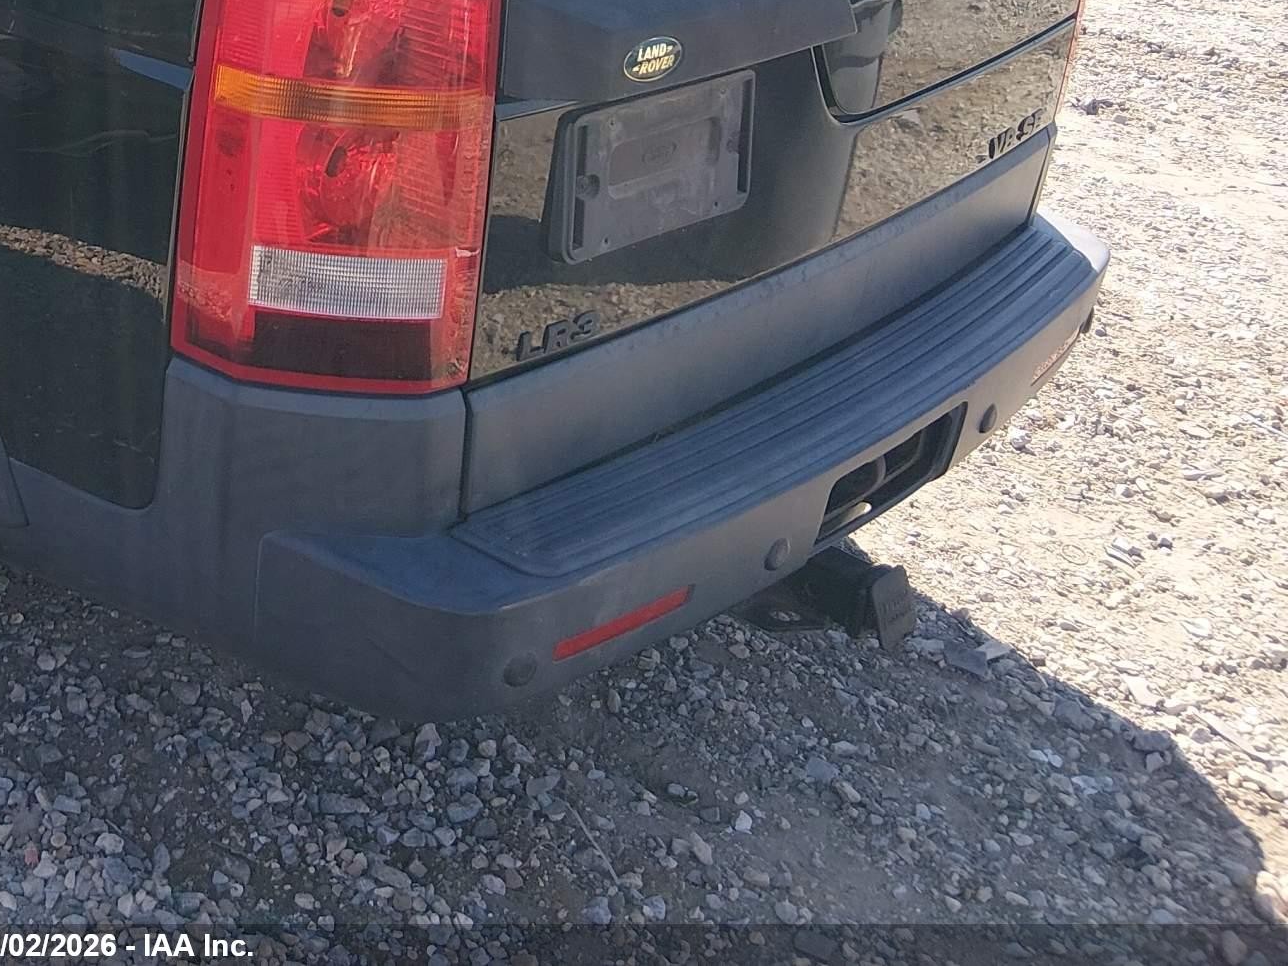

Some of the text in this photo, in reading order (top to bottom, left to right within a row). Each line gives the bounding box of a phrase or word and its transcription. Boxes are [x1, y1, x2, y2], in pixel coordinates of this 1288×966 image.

[637, 42, 667, 62] LAND
[639, 54, 675, 75] ROVER
[515, 309, 599, 363] LR3
